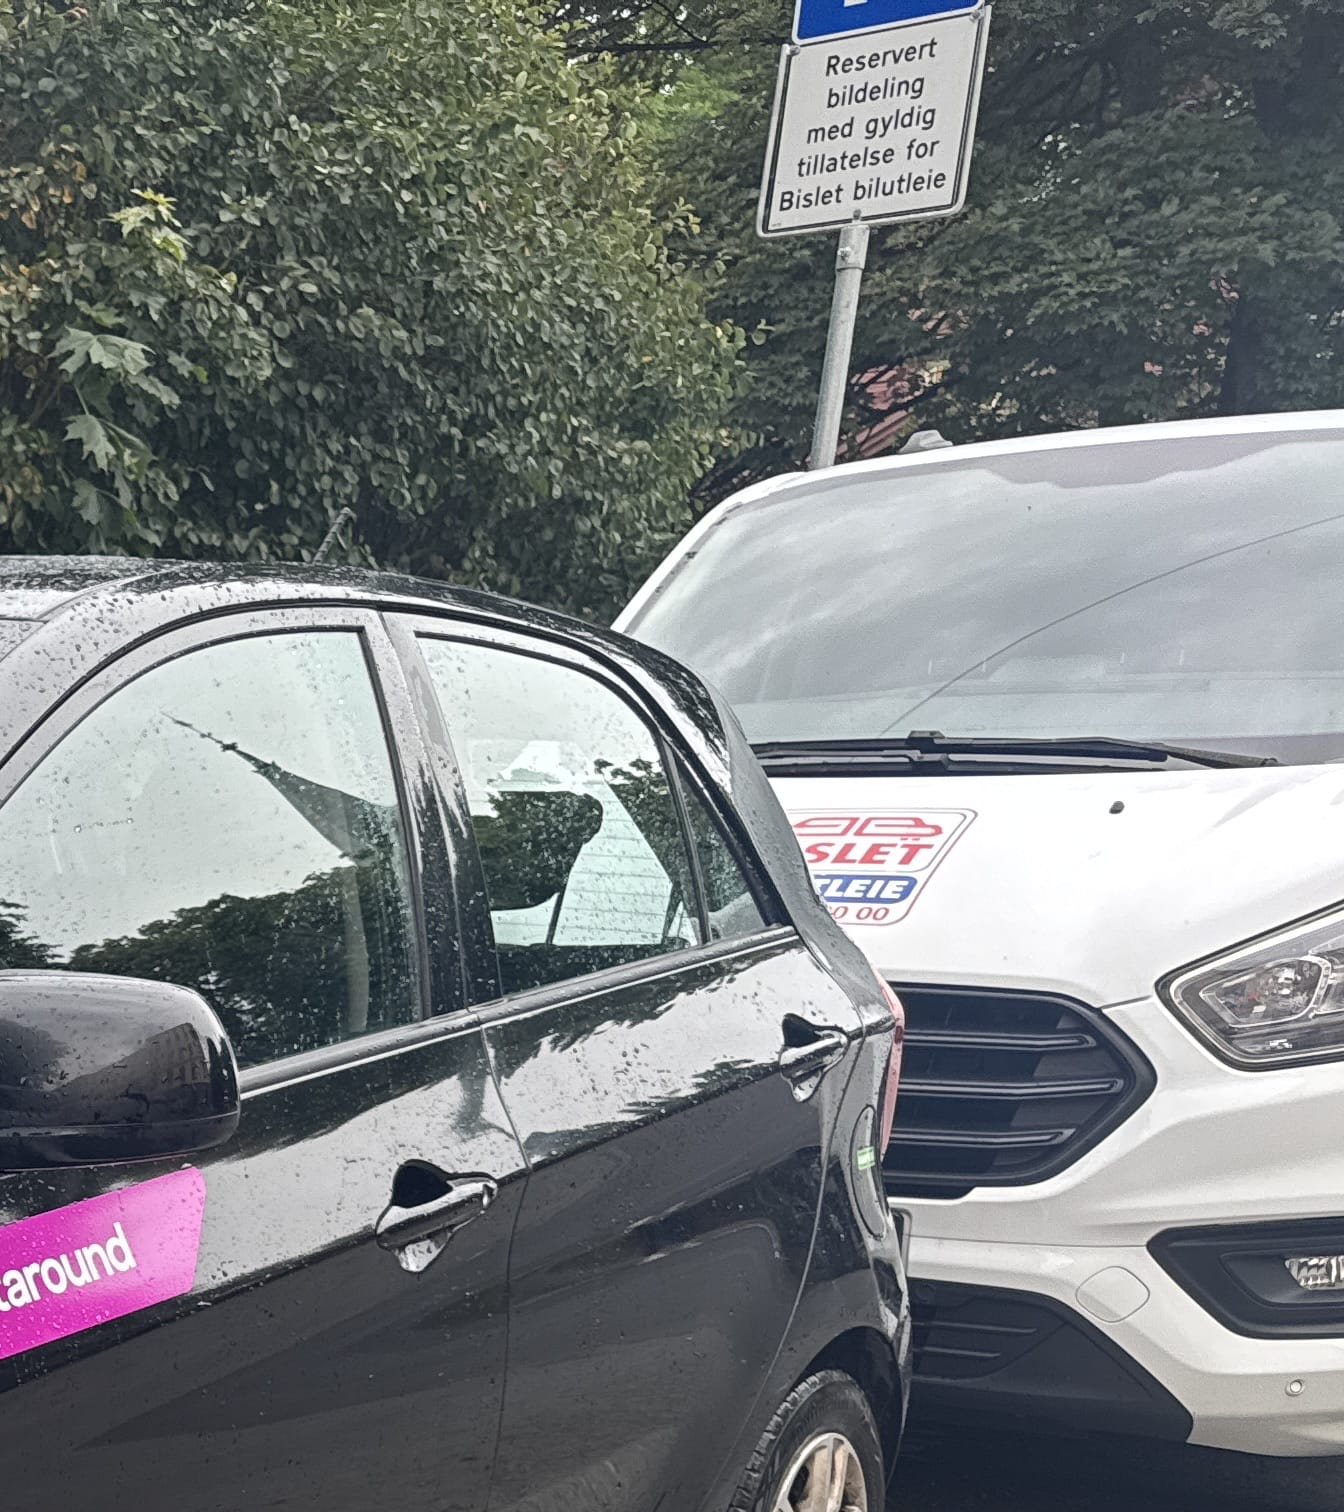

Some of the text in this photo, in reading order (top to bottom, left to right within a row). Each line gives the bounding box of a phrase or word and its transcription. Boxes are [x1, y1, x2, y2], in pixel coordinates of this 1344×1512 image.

[825, 37, 938, 77] Reservert
[826, 76, 925, 109] bildeling
[806, 106, 937, 145] med gyldig
[797, 138, 940, 178] tillatelse for
[779, 169, 947, 212] Bislet bilutleie
[804, 842, 935, 866] SLET
